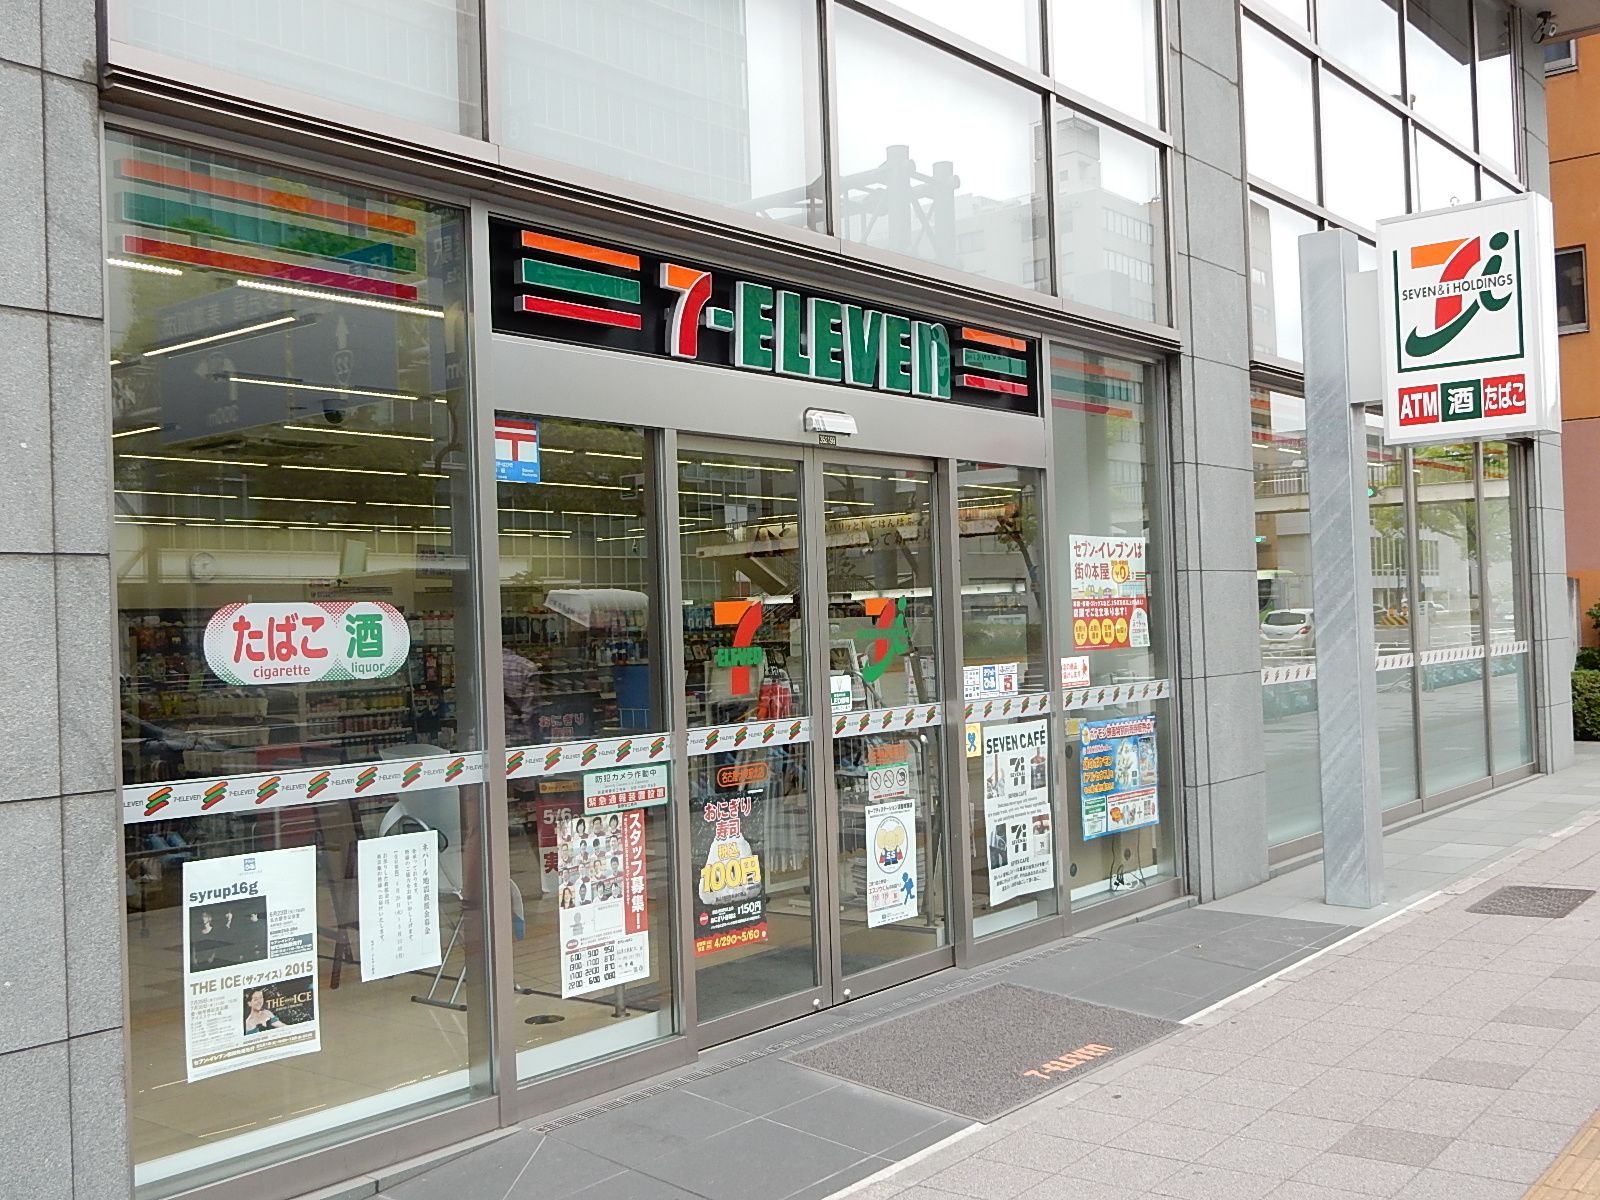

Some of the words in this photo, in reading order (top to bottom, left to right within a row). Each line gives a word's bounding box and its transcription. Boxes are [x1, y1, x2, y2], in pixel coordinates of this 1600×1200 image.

[1453, 273, 1513, 294] HOLDINGS
[1400, 389, 1438, 420] ATM
[1448, 386, 1475, 415] 酒
[1484, 382, 1525, 411] たばこ
[1074, 562, 1111, 581] 街の本屋
[232, 613, 329, 664] たばこ
[345, 613, 384, 659] 酒
[253, 664, 311, 680] cigarette
[351, 661, 385, 677] liquor
[986, 737, 1019, 755] SEVEN
[1020, 724, 1046, 749] CAFÉ
[595, 769, 657, 784] 防犯カメラ作動中
[704, 797, 752, 822] おにぎり
[715, 818, 741, 840] 寿司
[886, 850, 896, 860] SS
[700, 855, 762, 893] 100円
[189, 881, 259, 904] syrup16g
[190, 982, 217, 996] THE
[220, 974, 242, 990] ICE
[285, 960, 313, 977] 2015
[265, 997, 285, 1010] THE
[293, 991, 313, 1004] ICE
